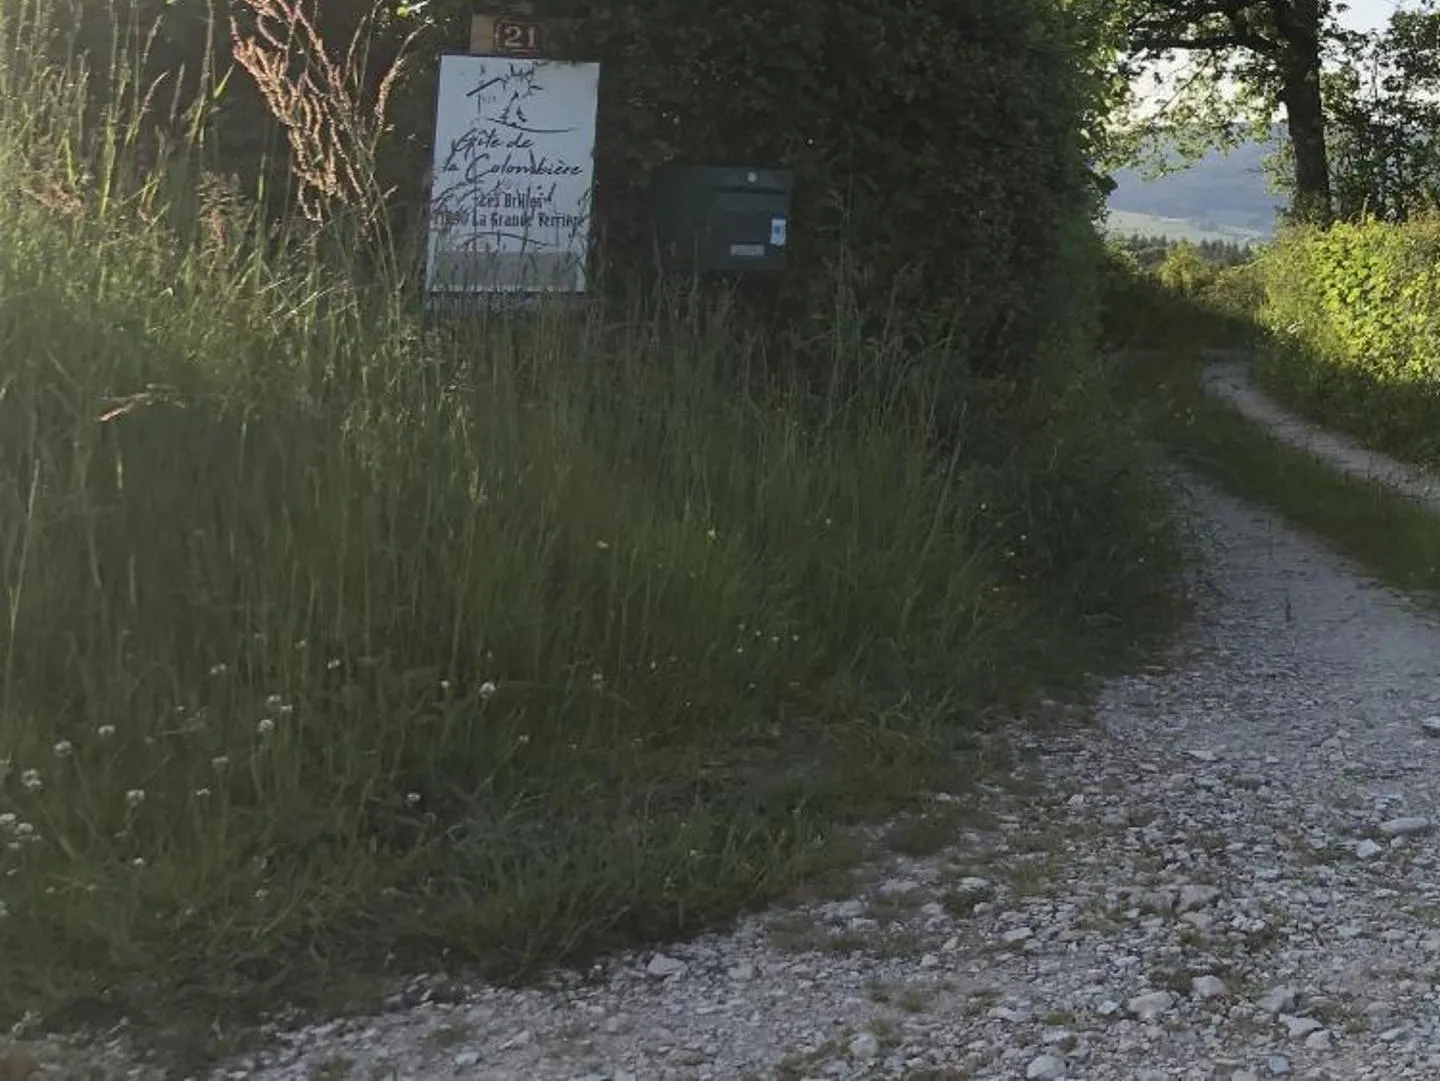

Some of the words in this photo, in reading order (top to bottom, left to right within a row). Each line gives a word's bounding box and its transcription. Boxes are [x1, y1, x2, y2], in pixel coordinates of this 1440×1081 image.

[504, 25, 536, 48] 21
[506, 132, 534, 149] de
[465, 152, 584, 185] Colombière
